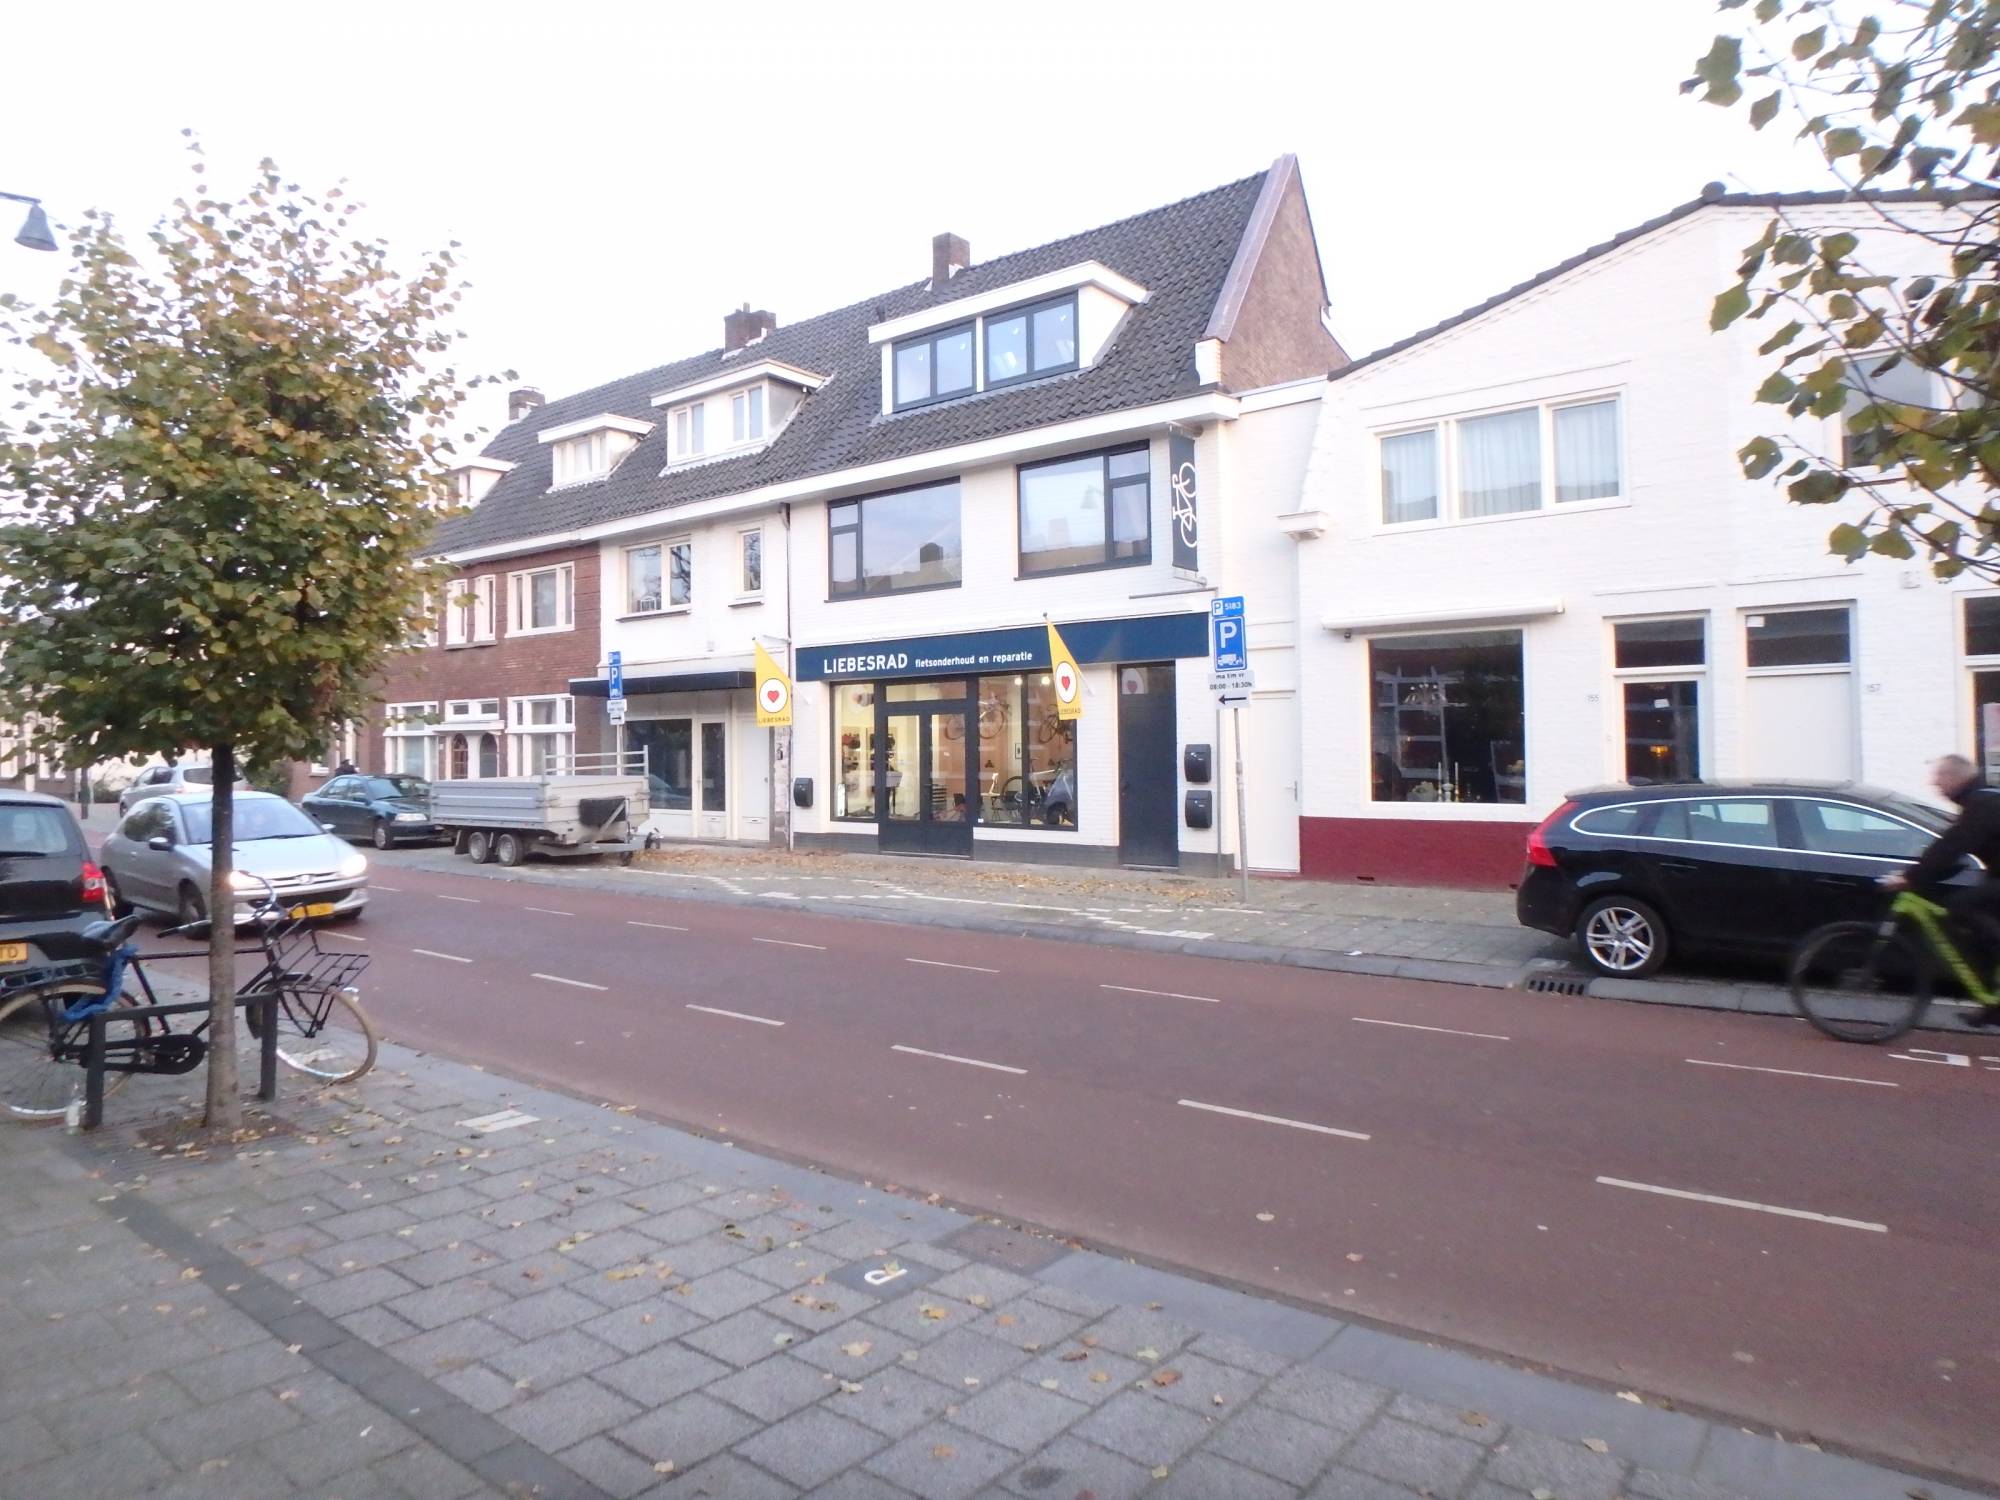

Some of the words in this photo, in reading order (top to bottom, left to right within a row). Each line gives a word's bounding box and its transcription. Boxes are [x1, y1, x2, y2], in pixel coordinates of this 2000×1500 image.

[1224, 601, 1241, 610] 5183
[1219, 621, 1237, 649] P
[823, 653, 908, 674] LIEBESRAD
[915, 655, 975, 668] fietsonderhoud
[978, 655, 989, 664] en
[992, 651, 1033, 664] reparatie
[611, 667, 618, 685] P
